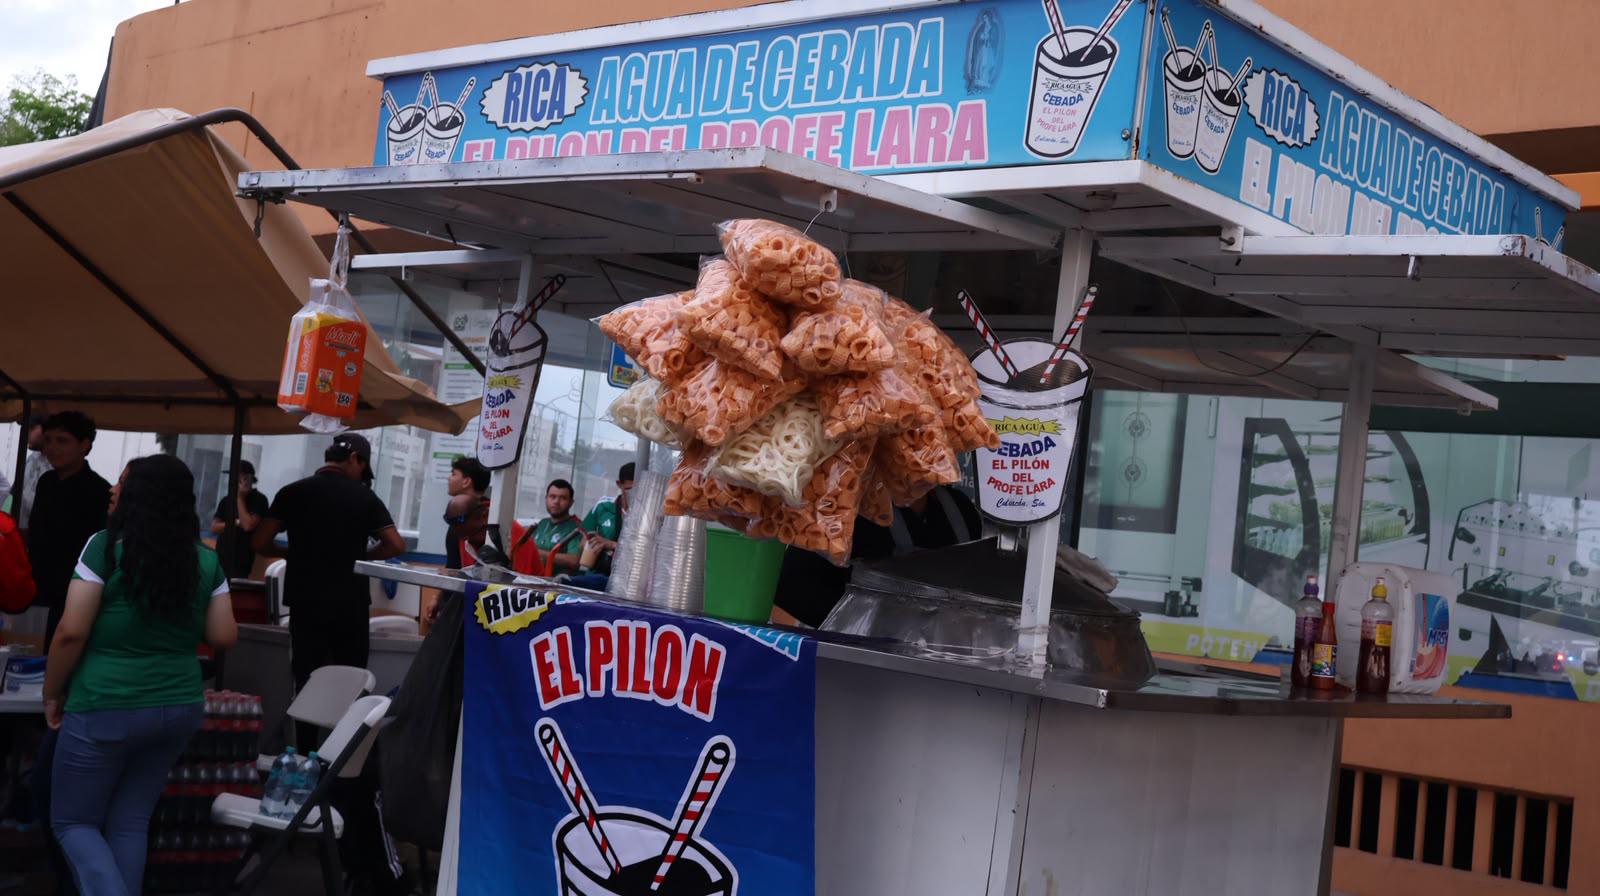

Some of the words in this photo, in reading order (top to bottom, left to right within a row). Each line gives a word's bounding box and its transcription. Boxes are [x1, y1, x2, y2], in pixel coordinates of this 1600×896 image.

[502, 66, 566, 125] RICA
[590, 47, 697, 125] AGUA
[700, 41, 760, 116] DE
[760, 17, 944, 111] CEBADA
[1043, 92, 1084, 106] CEBADA
[1172, 102, 1195, 115] CEBADA
[851, 99, 988, 171] LARA
[1037, 118, 1056, 132] PROFE
[1057, 122, 1077, 133] LARA
[1260, 70, 1308, 144] RICA
[1320, 90, 1391, 198] AGUA
[1389, 128, 1425, 212] DE
[1422, 145, 1505, 235] CEBADA
[1240, 137, 1272, 212] EL
[1273, 153, 1351, 235] PILON
[485, 389, 516, 408] CEBADA
[493, 425, 513, 440] LARA
[995, 423, 1017, 431] RICA
[1018, 423, 1046, 431] AGUA
[992, 459, 1008, 470] EL
[1011, 457, 1050, 470] PILÓN
[987, 476, 1024, 495] PROFE
[1026, 477, 1056, 495] LARA
[1012, 472, 1034, 482] DEL
[481, 588, 548, 625] RICA
[1186, 632, 1261, 659] POTEN
[529, 626, 584, 711] EL
[584, 620, 727, 722] PILON
